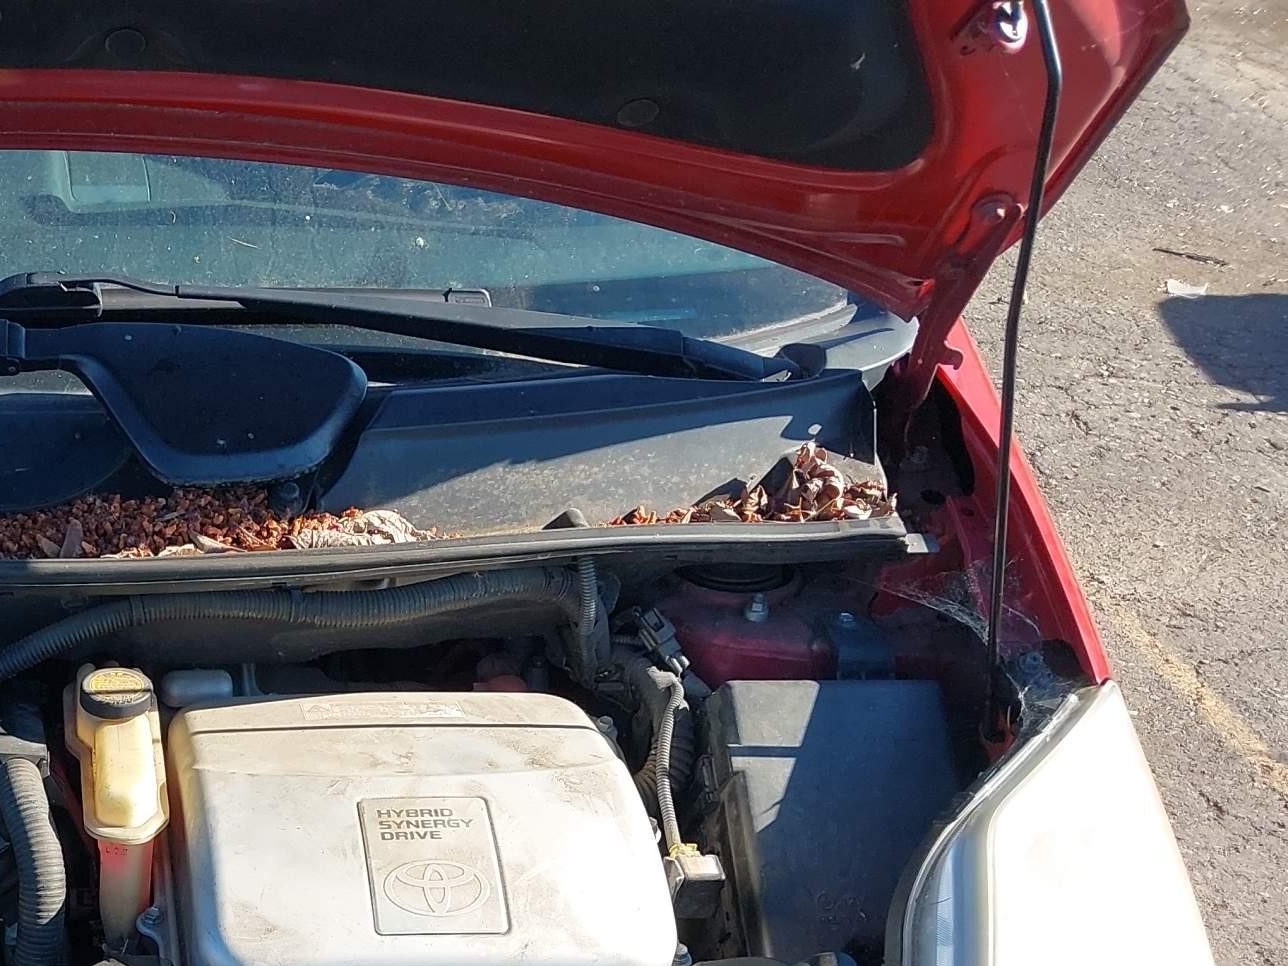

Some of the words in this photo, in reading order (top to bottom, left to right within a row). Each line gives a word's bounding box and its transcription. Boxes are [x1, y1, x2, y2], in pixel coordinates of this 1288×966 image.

[376, 808, 453, 818] HYBRID
[379, 819, 473, 829] SYNERGY
[381, 830, 443, 841] DRIVE
